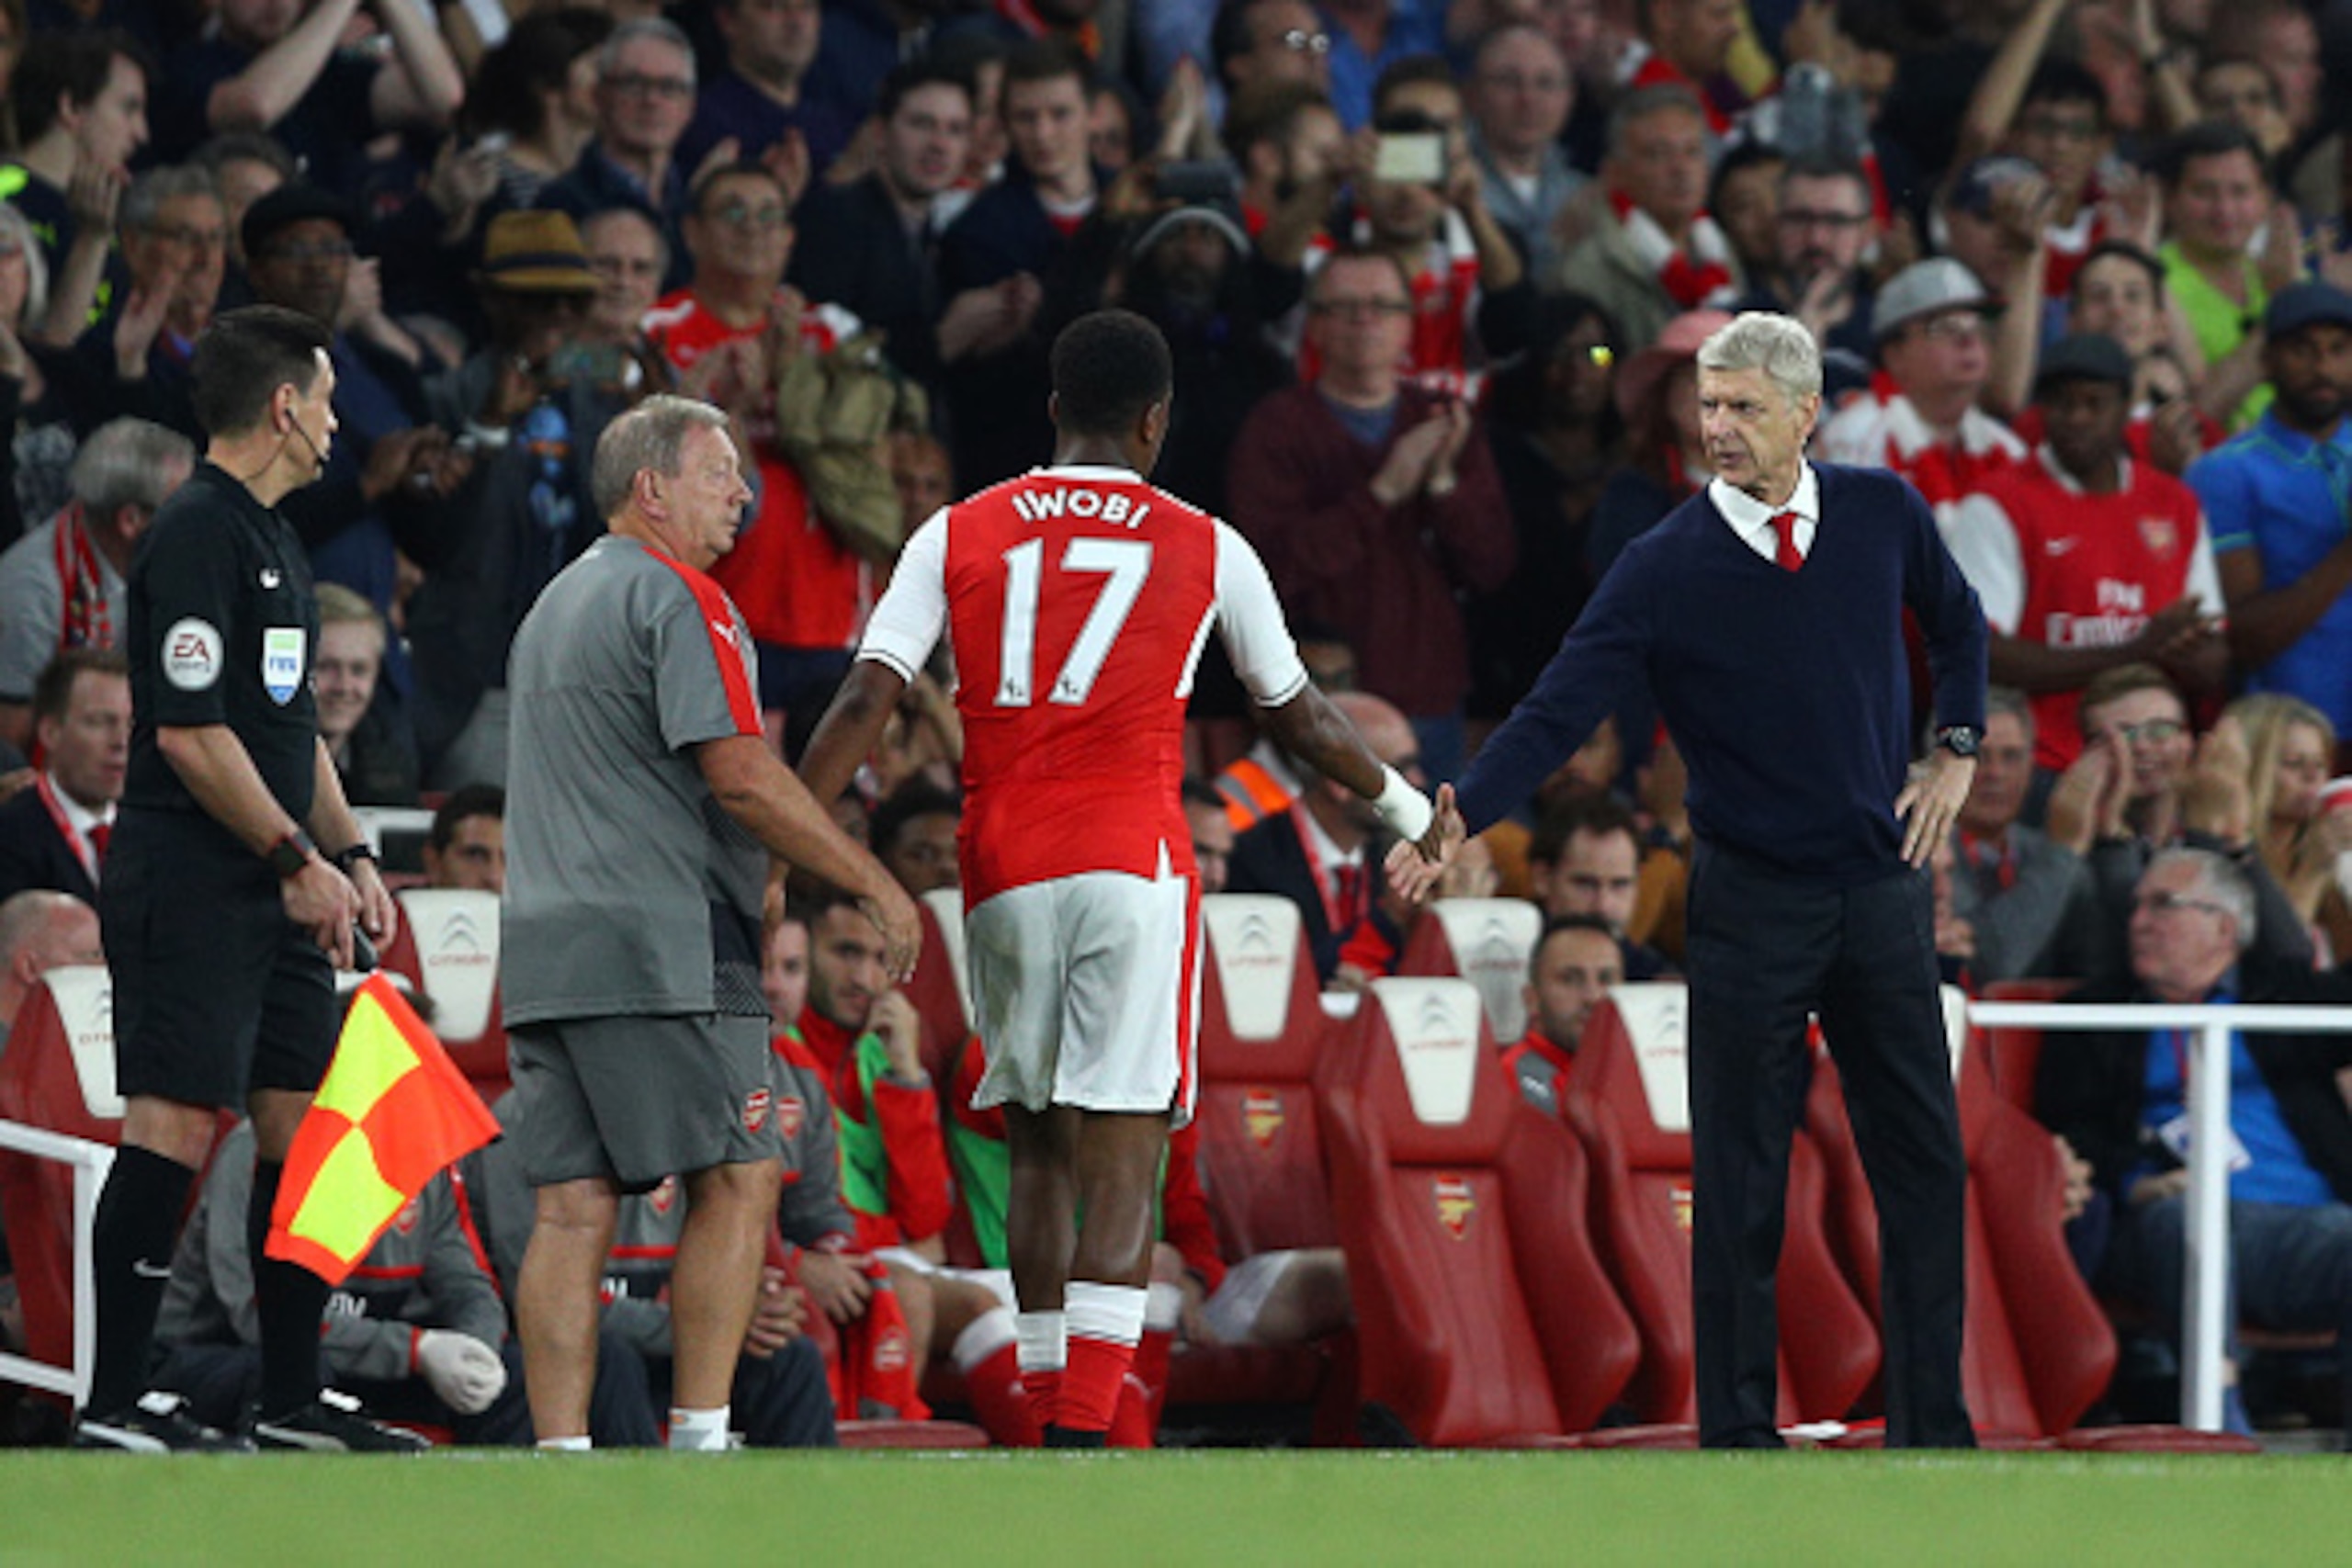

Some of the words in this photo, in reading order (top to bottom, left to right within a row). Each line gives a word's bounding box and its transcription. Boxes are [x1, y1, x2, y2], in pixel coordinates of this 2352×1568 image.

[1012, 487, 1150, 529] IWOBI
[994, 536, 1154, 706] 17
[175, 634, 210, 660] EA
